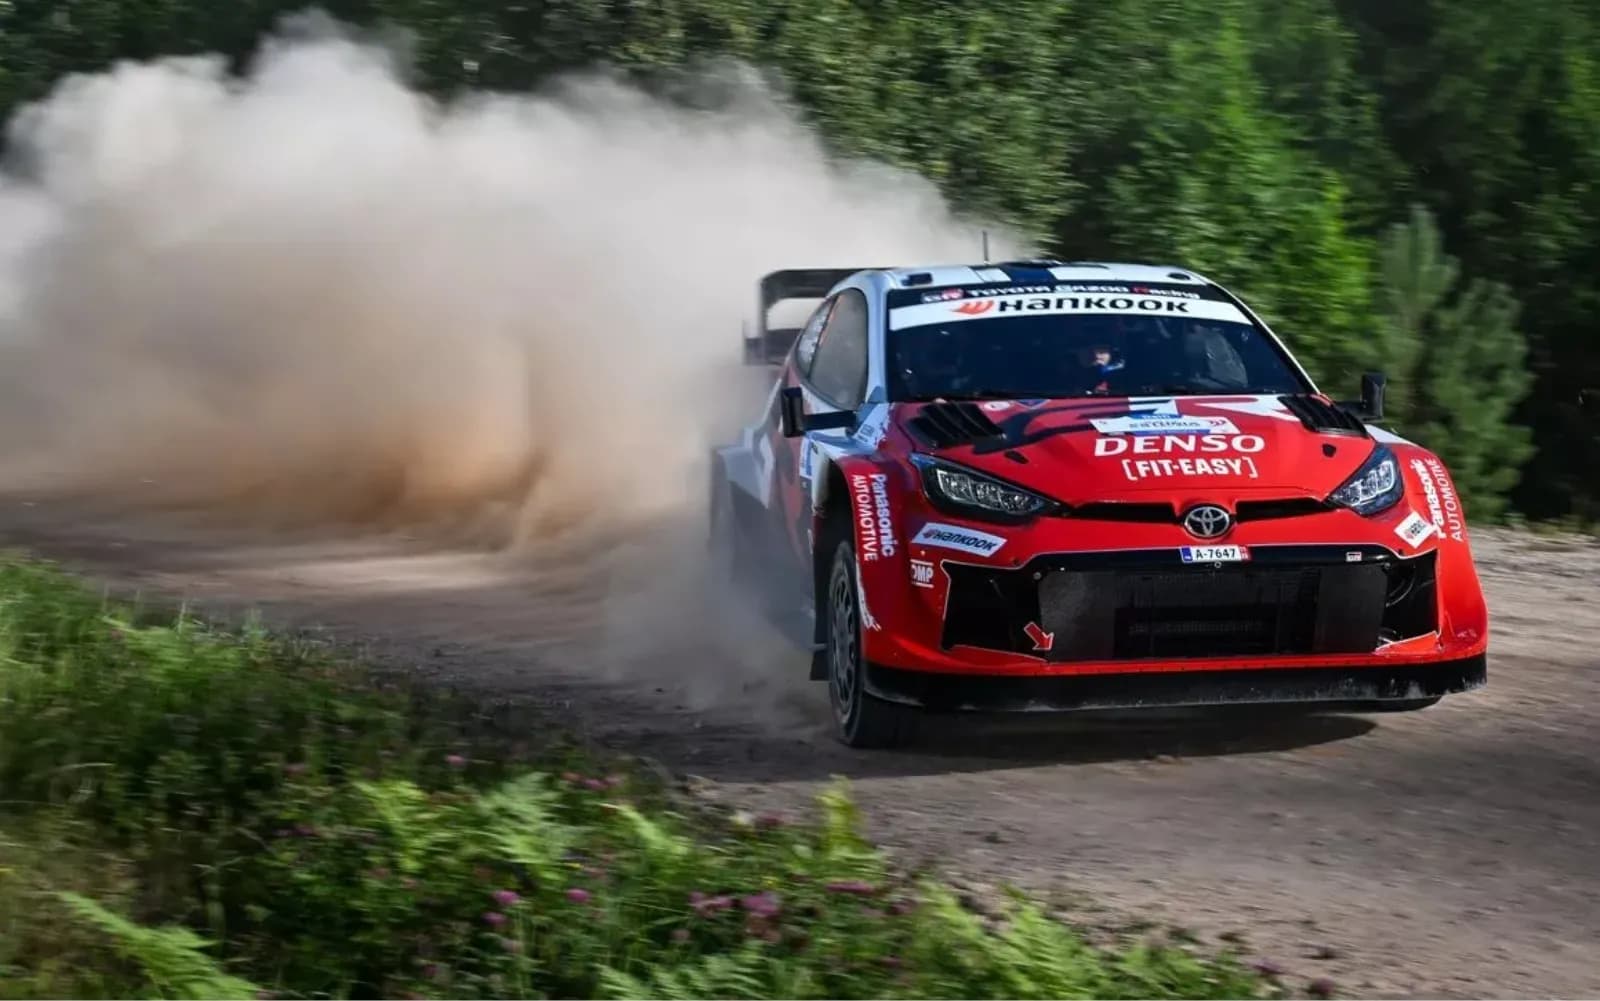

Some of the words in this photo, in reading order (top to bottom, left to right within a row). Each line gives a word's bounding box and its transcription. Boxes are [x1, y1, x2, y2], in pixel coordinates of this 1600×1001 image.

[967, 286, 1051, 298] TOYOTA
[1055, 285, 1130, 293] GAZOO
[1094, 434, 1265, 457] DENSO
[852, 474, 879, 562] AUTOMOTIVE
[869, 474, 899, 557] Panasonic
[1410, 458, 1447, 539] Panasonic
[1424, 457, 1464, 542] AUTOMOTIVE
[1195, 548, 1236, 560] A-7647
